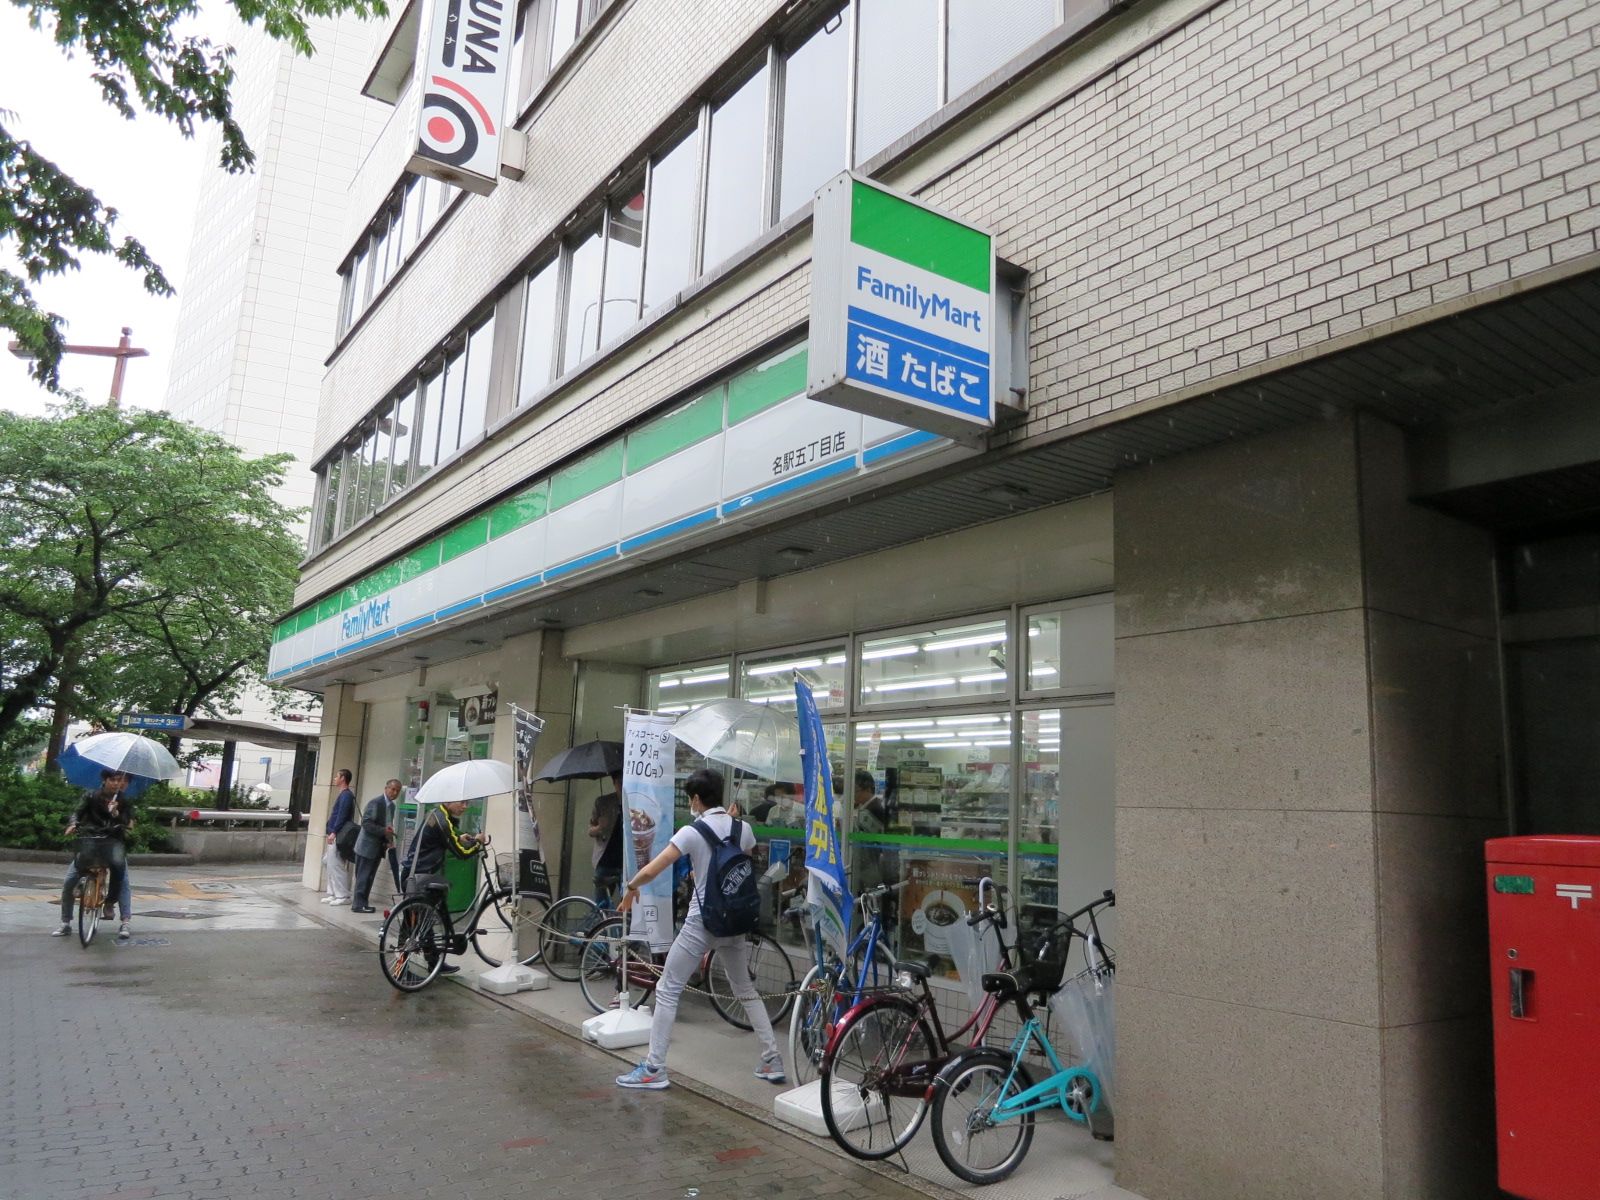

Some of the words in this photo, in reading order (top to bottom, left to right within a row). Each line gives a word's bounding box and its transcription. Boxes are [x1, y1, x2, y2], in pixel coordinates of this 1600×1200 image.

[856, 266, 982, 332] FamilyMart
[855, 333, 890, 381] 酒
[900, 352, 982, 406] たばこ
[771, 431, 846, 476] 名駅五丁目店
[341, 595, 391, 640] FamilyMart
